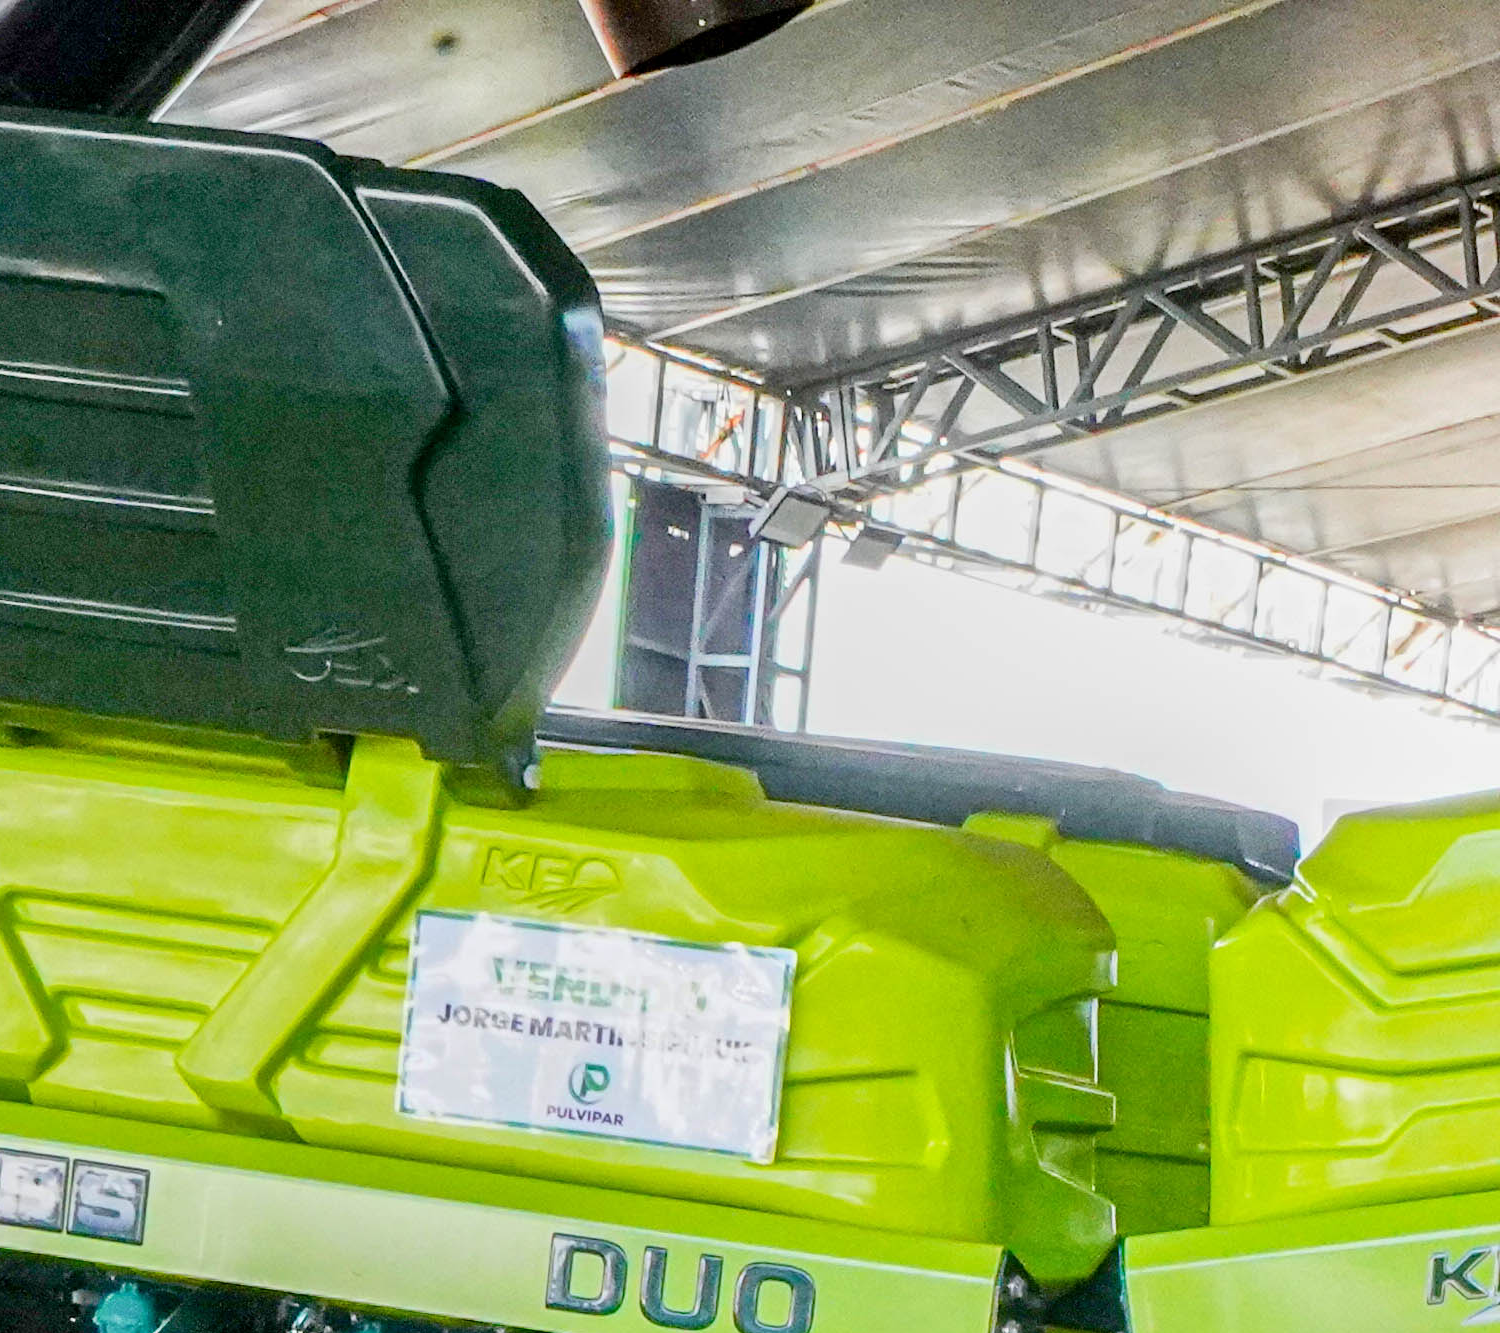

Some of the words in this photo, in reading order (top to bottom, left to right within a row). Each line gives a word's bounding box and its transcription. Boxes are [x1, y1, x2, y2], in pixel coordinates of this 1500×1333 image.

[481, 846, 574, 891] KF
[438, 1003, 525, 1034] JORGE
[546, 1105, 625, 1127] PULVIPAR
